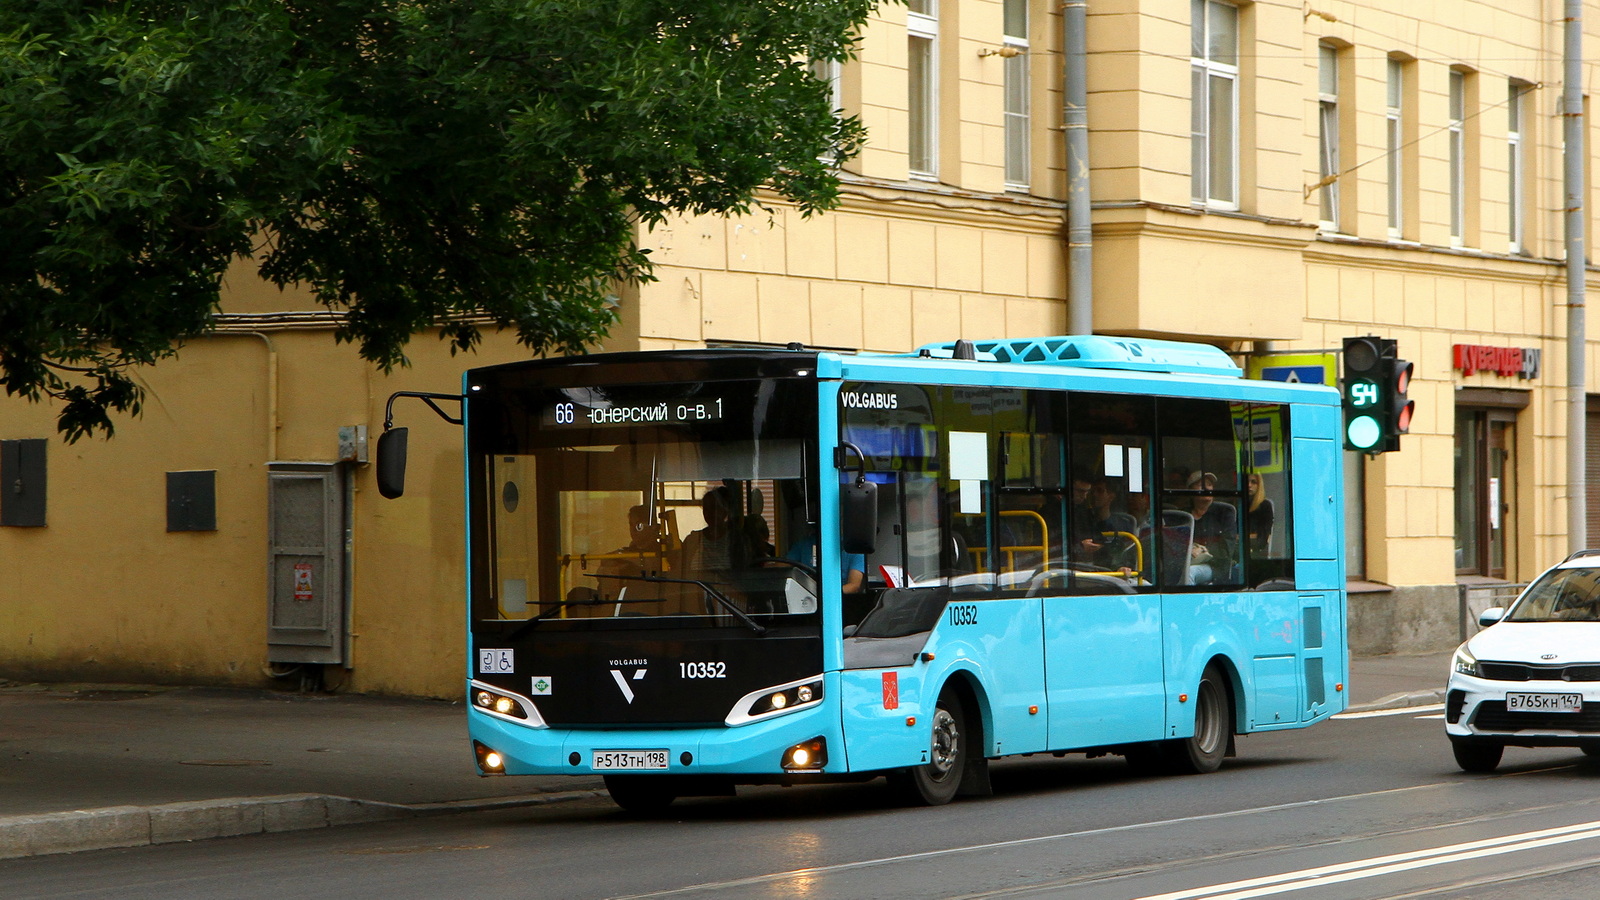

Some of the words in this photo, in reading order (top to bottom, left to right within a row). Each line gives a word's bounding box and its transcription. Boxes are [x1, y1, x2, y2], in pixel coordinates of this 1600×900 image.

[841, 392, 898, 409] VOLGABUS
[1352, 384, 1376, 406] 54
[555, 402, 574, 423] 66
[949, 605, 978, 626] 10352
[609, 658, 648, 666] VOLGABUS
[679, 661, 727, 679] 10352
[1561, 695, 1579, 706] 147
[647, 752, 665, 763] 198
